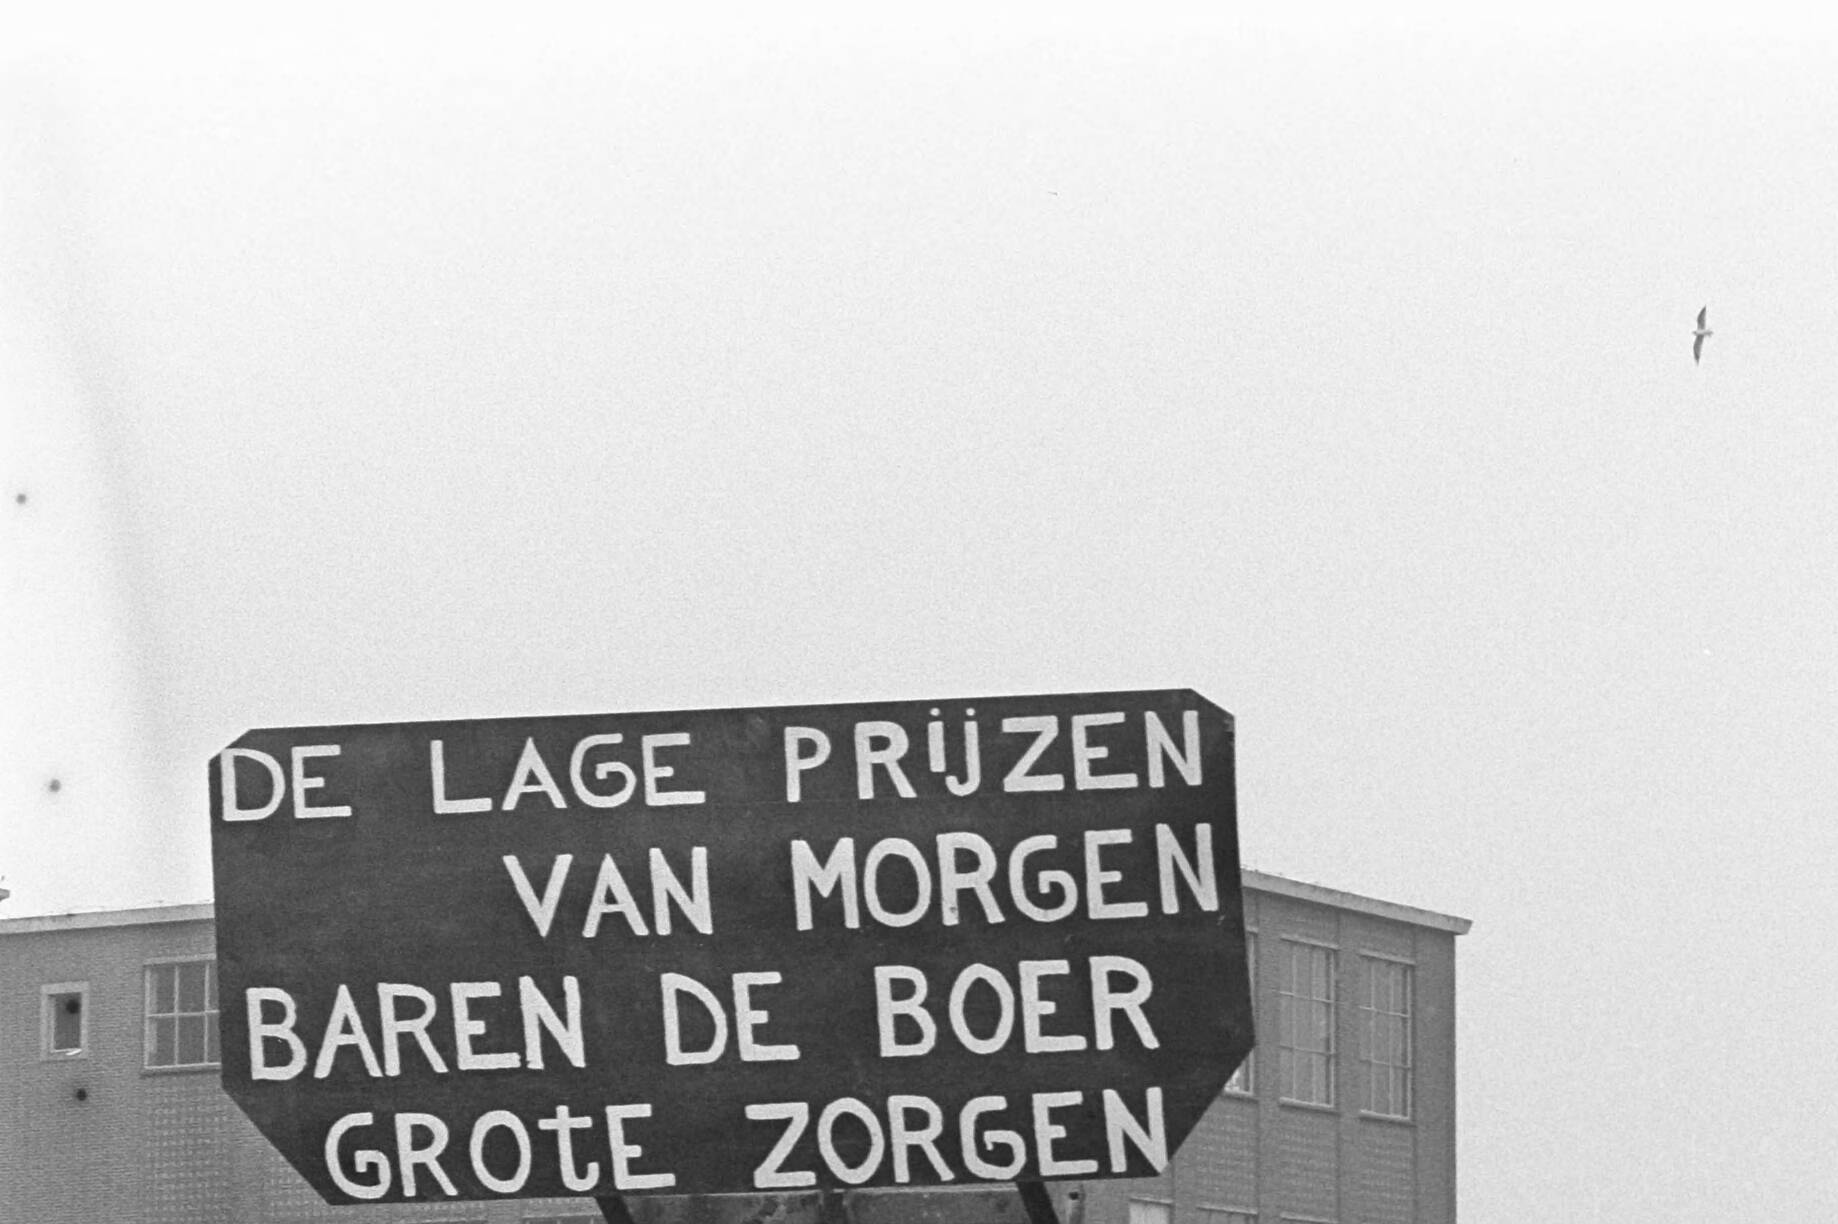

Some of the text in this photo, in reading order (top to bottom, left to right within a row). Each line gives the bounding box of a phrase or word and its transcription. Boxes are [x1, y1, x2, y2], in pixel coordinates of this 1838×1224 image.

[220, 744, 353, 822] DE
[430, 732, 706, 815] LAGE
[502, 822, 1219, 938] VAN MORGEN
[245, 955, 1160, 1081] BAREN DE BOER
[744, 1087, 1169, 1189] ZORGEN
